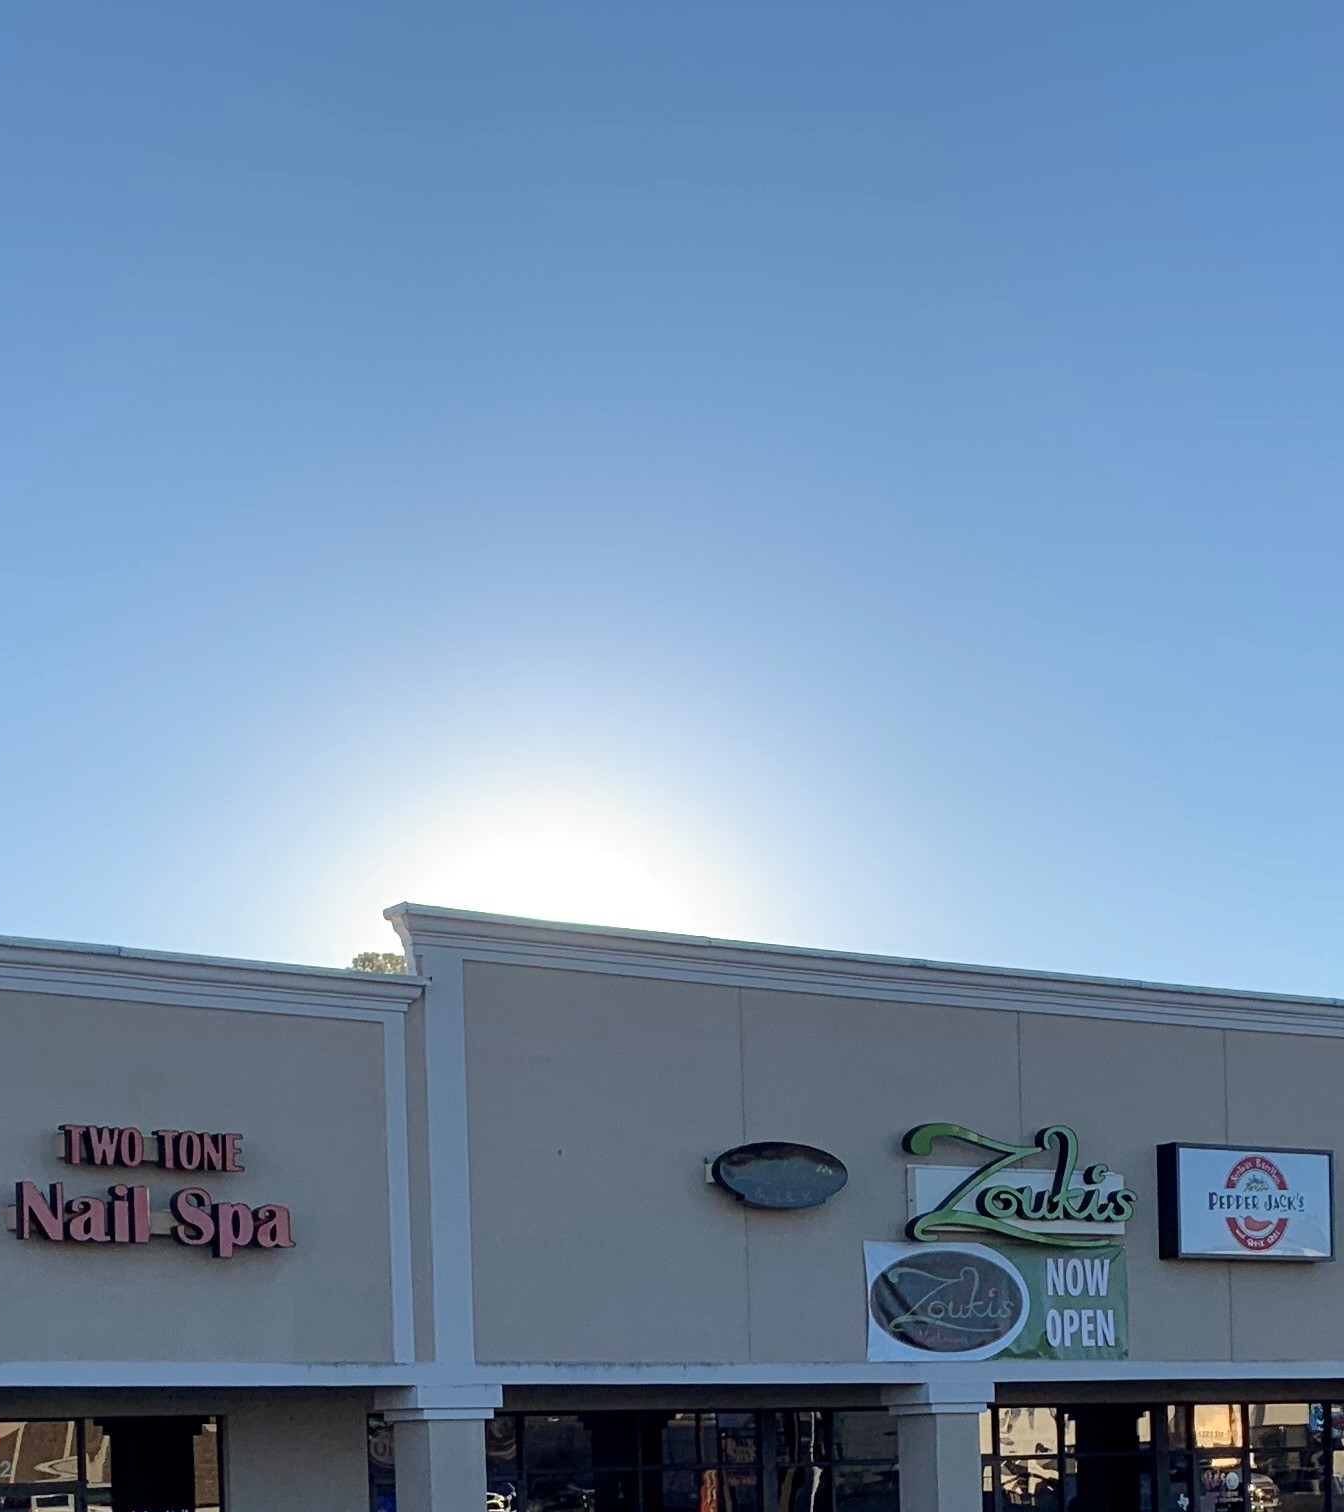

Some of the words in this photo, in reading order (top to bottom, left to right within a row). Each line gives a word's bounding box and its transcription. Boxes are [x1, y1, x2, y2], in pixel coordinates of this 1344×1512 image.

[58, 1124, 144, 1167] TWO
[152, 1129, 244, 1172] TONE
[16, 1181, 150, 1243] Nail
[171, 1186, 296, 1258] Spa
[1208, 1192, 1259, 1211] PEPPER
[1264, 1192, 1305, 1212] JACK'S
[1045, 1257, 1111, 1297] NOW
[1045, 1308, 1116, 1348] OPEN
